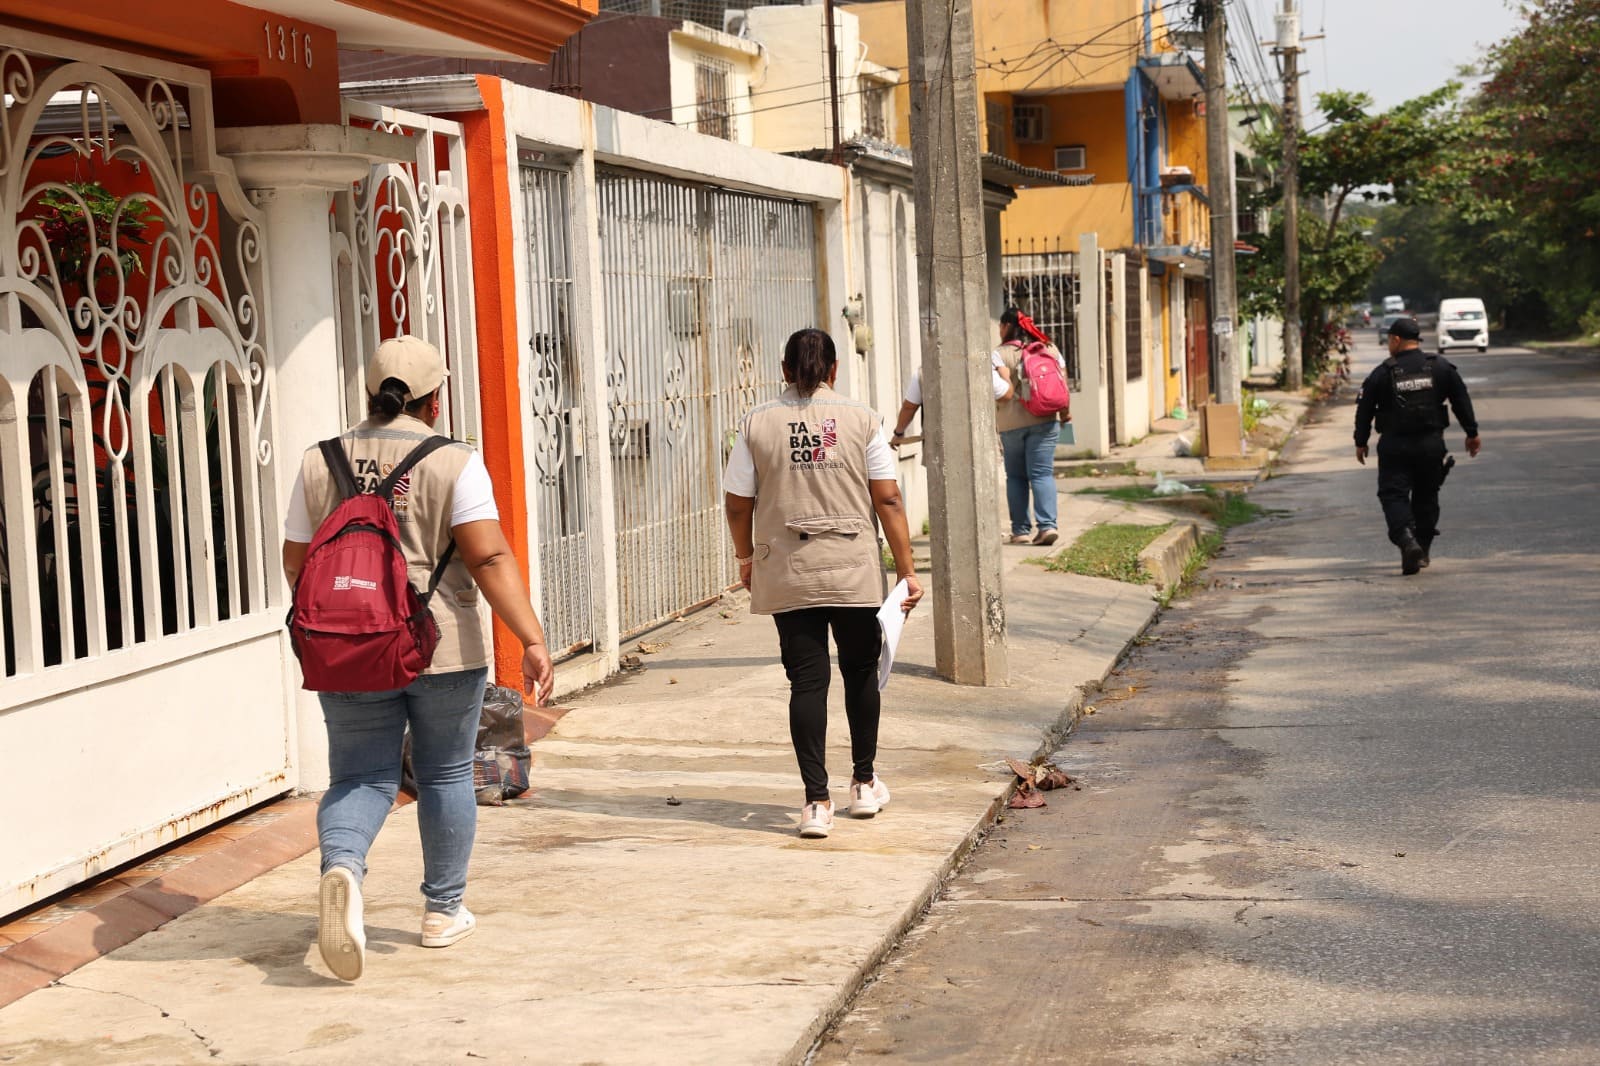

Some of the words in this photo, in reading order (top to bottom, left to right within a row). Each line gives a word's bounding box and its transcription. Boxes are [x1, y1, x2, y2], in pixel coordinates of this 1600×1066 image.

[264, 21, 313, 69] 1316
[787, 421, 809, 434] TA
[790, 435, 822, 449] BAS
[790, 450, 812, 463] CO
[355, 459, 380, 476] TA
[355, 477, 386, 493] BA
